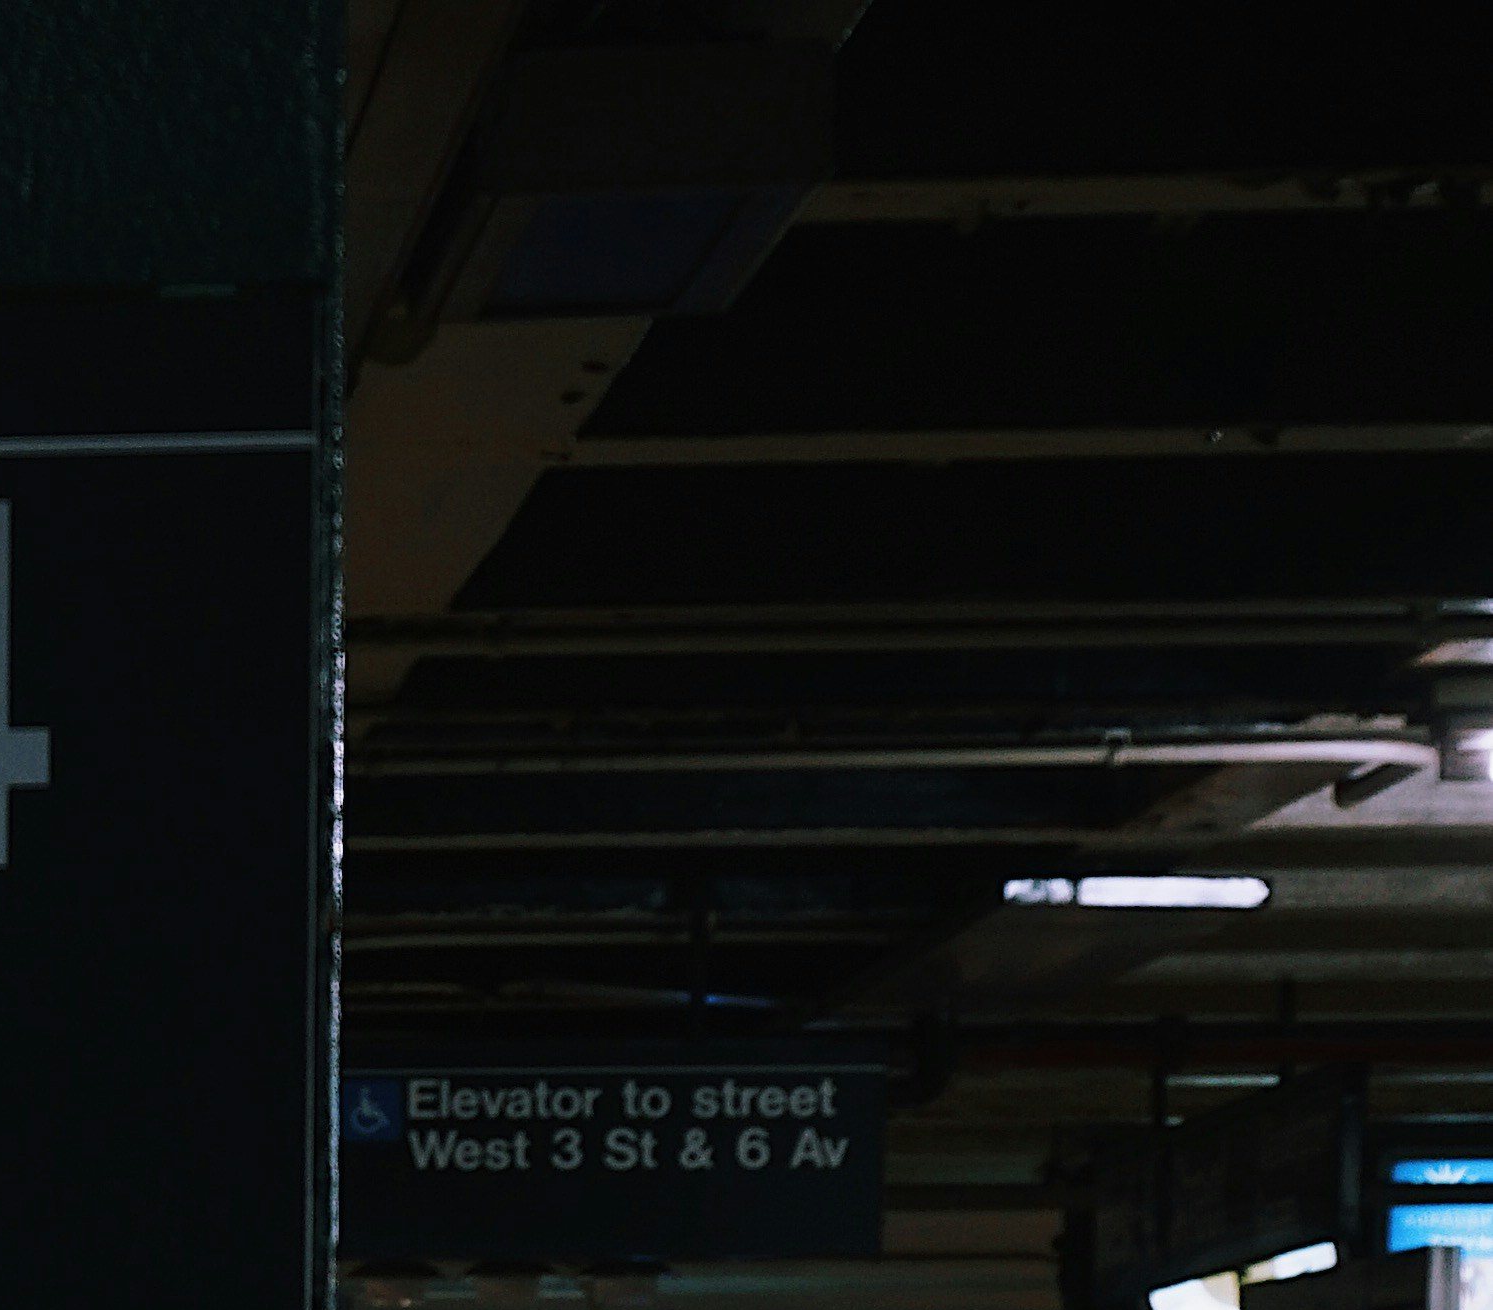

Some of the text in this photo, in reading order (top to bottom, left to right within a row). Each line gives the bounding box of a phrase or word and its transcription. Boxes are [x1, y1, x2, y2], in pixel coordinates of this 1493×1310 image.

[407, 1078, 837, 1119] Elevator to street
[407, 1126, 851, 1170] West 3 St & 6 Av
